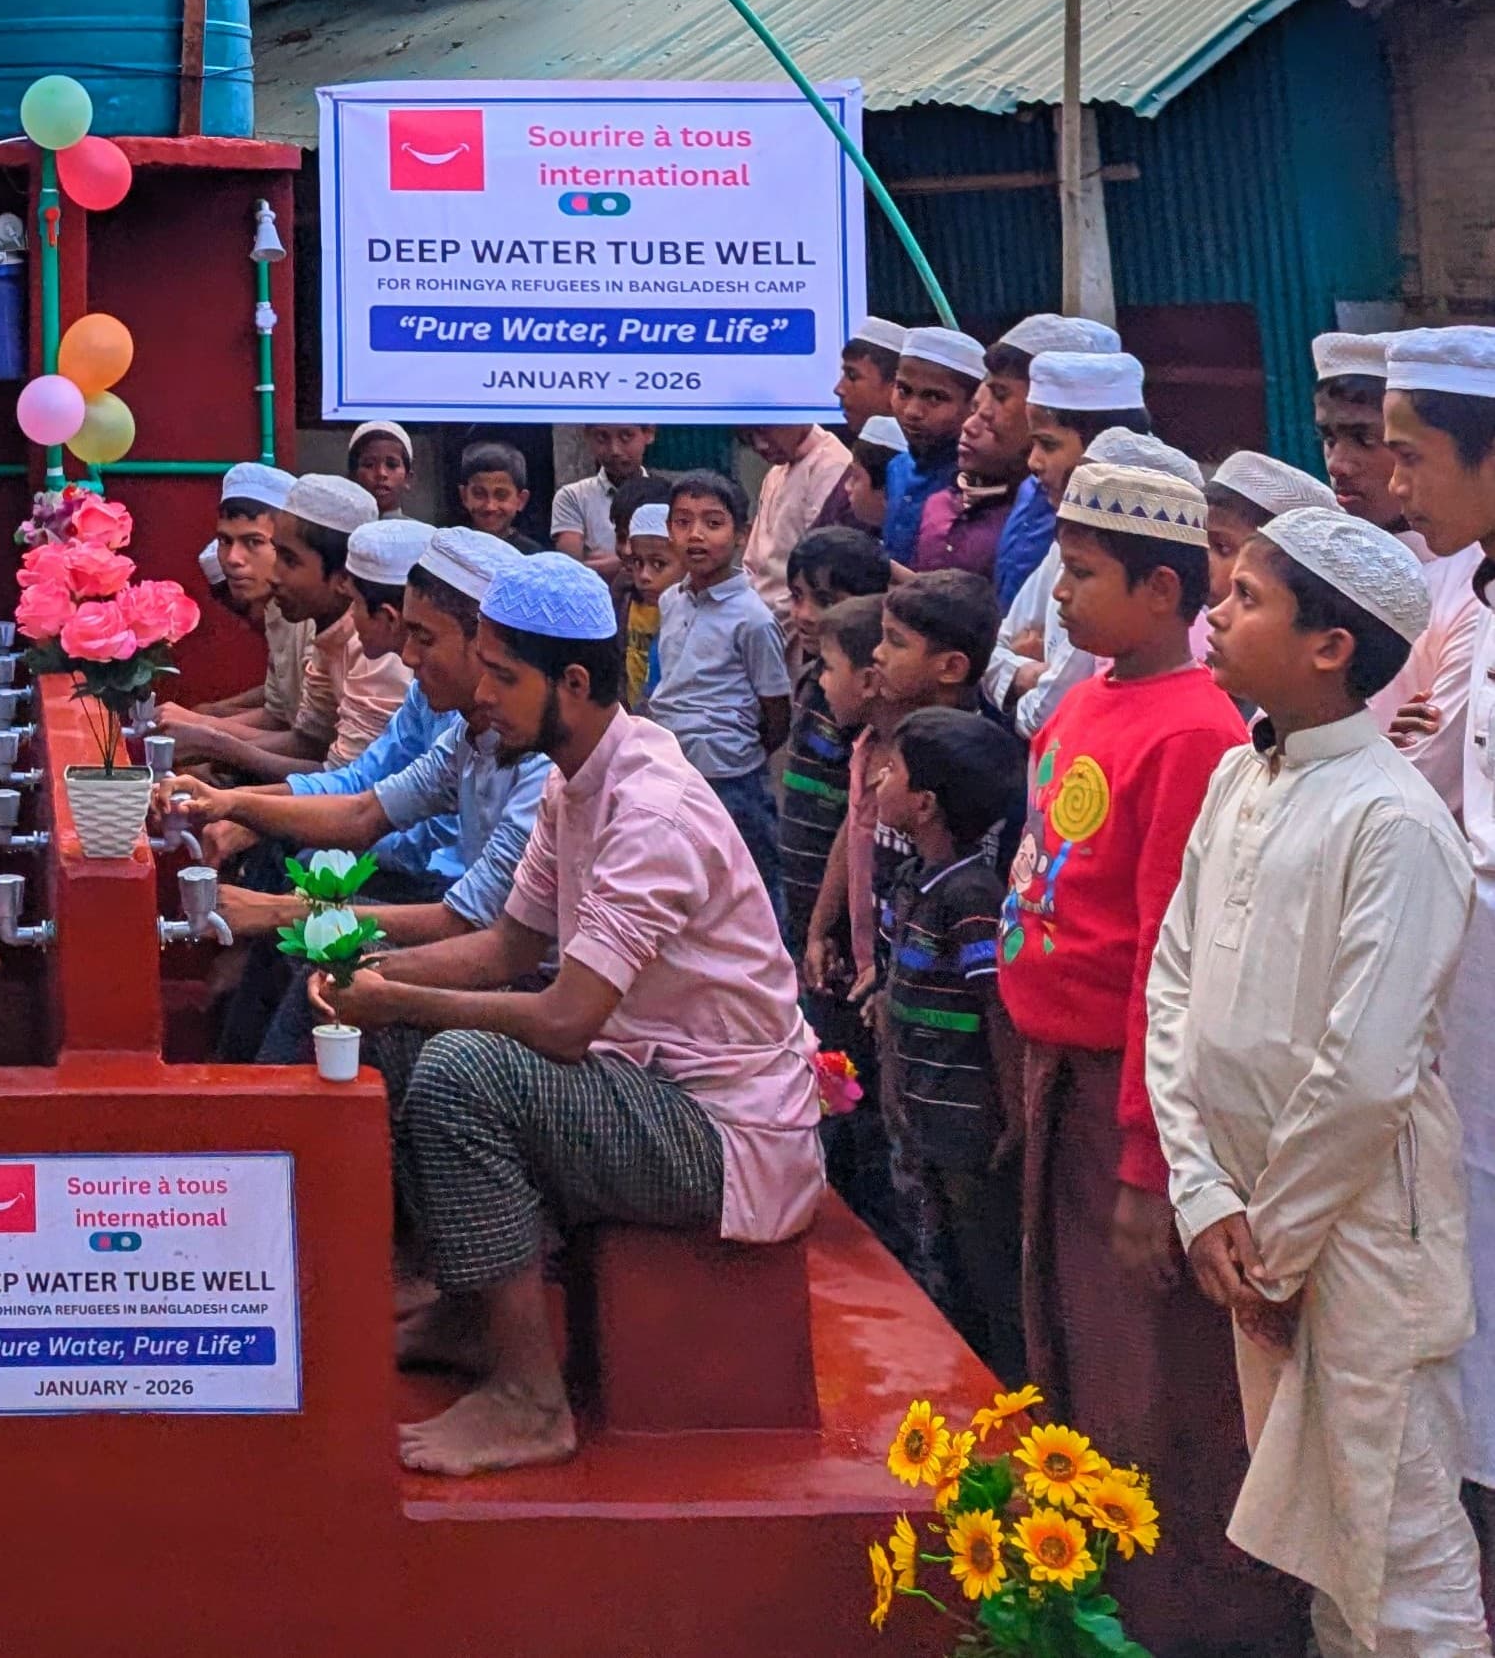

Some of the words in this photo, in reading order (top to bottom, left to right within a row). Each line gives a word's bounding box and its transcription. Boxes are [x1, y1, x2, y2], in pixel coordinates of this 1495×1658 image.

[529, 125, 644, 147] Sourire
[654, 125, 672, 147] à
[680, 128, 752, 147] tous
[541, 163, 749, 186] international
[368, 239, 460, 262] DEEP
[471, 240, 596, 264] WATER
[607, 241, 704, 264] TUBE
[716, 241, 816, 265] WELL
[378, 278, 410, 290] FOR
[416, 279, 506, 291] ROHINGYA
[512, 280, 600, 292] REFUGEES
[606, 281, 623, 292] IN
[629, 281, 749, 292] BANGLADESH
[755, 281, 805, 293] CAMP
[400, 316, 491, 340] “Pure
[503, 318, 607, 347] Water,
[619, 319, 696, 342] Pure
[706, 318, 788, 342] Life”
[483, 371, 610, 389] JANUARY
[636, 372, 701, 389] 2026
[68, 1176, 151, 1195] Sourire
[158, 1176, 171, 1194] à
[176, 1178, 227, 1194] tous
[76, 1208, 227, 1228] international
[26, 1272, 116, 1293] WATER
[124, 1272, 195, 1291] TUBE
[203, 1271, 275, 1291] WELL
[55, 1304, 120, 1315] REFUGEES
[124, 1305, 136, 1314] IN
[141, 1304, 227, 1314] BANGLADESH
[231, 1304, 268, 1314] CAMP
[49, 1337, 124, 1359] Water,
[134, 1337, 189, 1355] Pure
[197, 1335, 256, 1354] Life”
[35, 1380, 127, 1396] JANUARY
[146, 1380, 193, 1395] 2026
